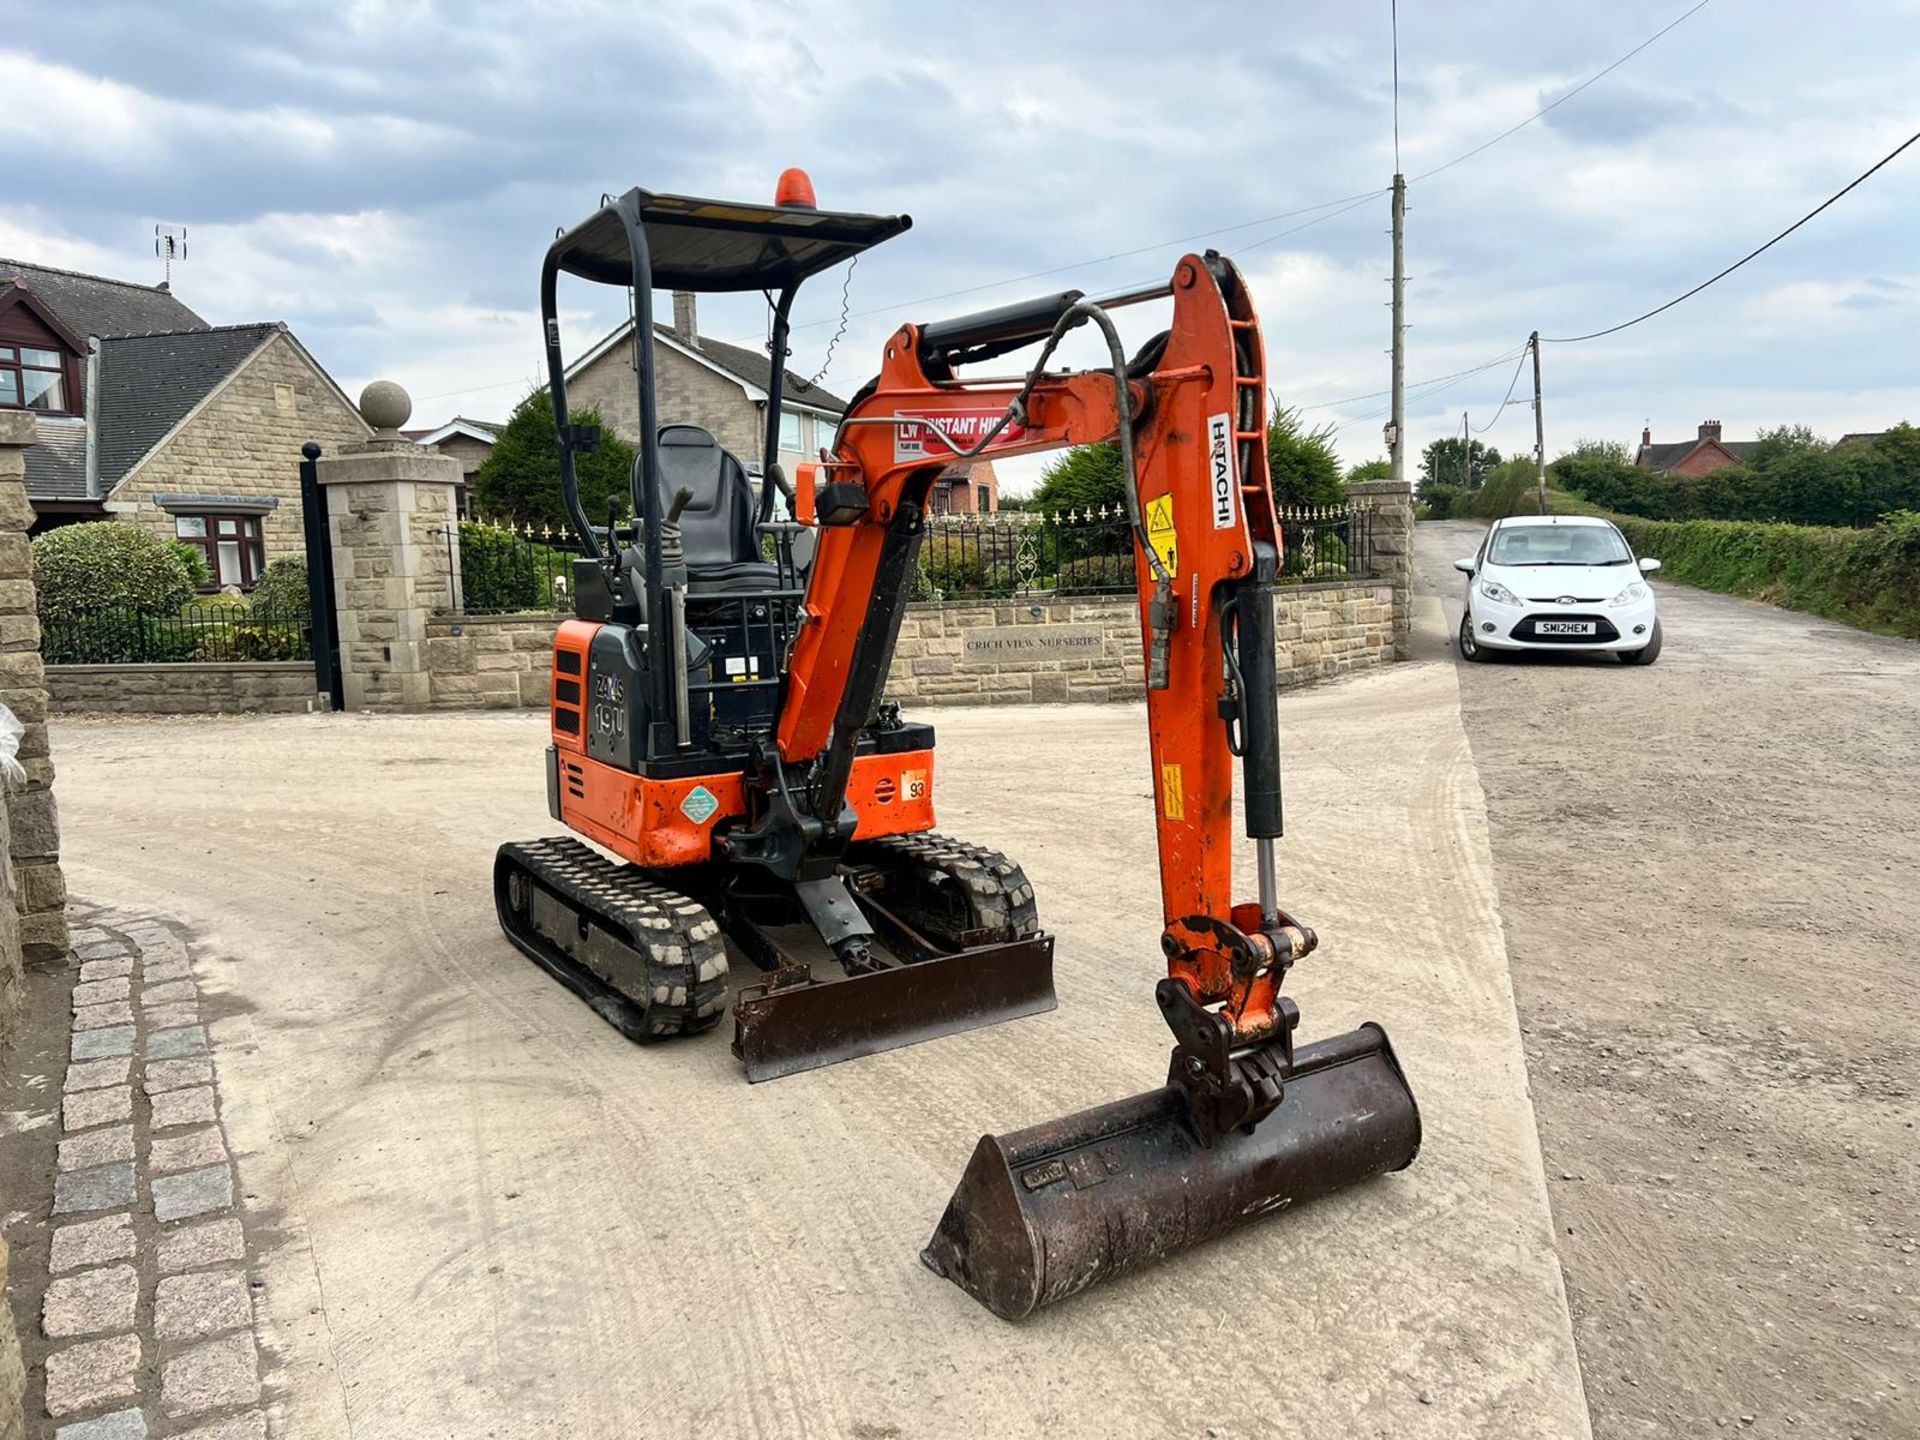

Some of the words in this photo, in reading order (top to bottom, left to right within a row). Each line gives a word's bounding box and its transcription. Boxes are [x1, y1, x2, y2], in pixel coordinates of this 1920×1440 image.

[967, 640, 1002, 650] CRICH
[1006, 639, 1034, 649] VIEW
[1040, 635, 1100, 647] NURSERIES
[910, 782, 924, 797] 93
